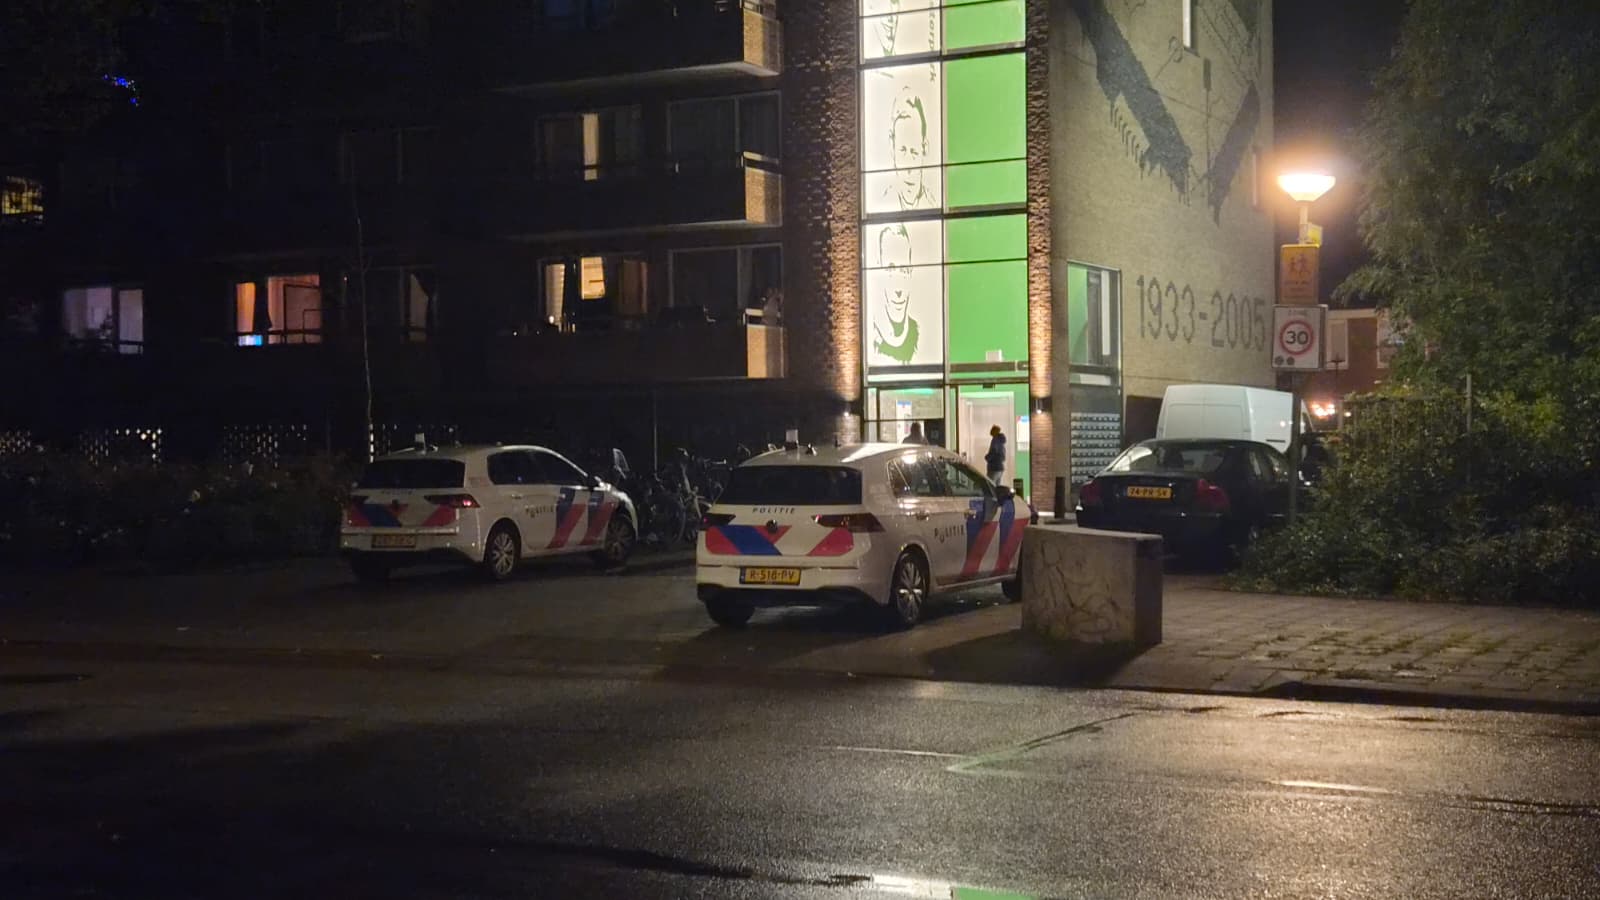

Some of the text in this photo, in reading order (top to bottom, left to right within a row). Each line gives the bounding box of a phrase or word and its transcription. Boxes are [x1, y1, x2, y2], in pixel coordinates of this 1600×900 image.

[1136, 274, 1265, 352] 1933-2005
[1285, 330, 1309, 345] 30
[934, 524, 964, 544] POLITIE
